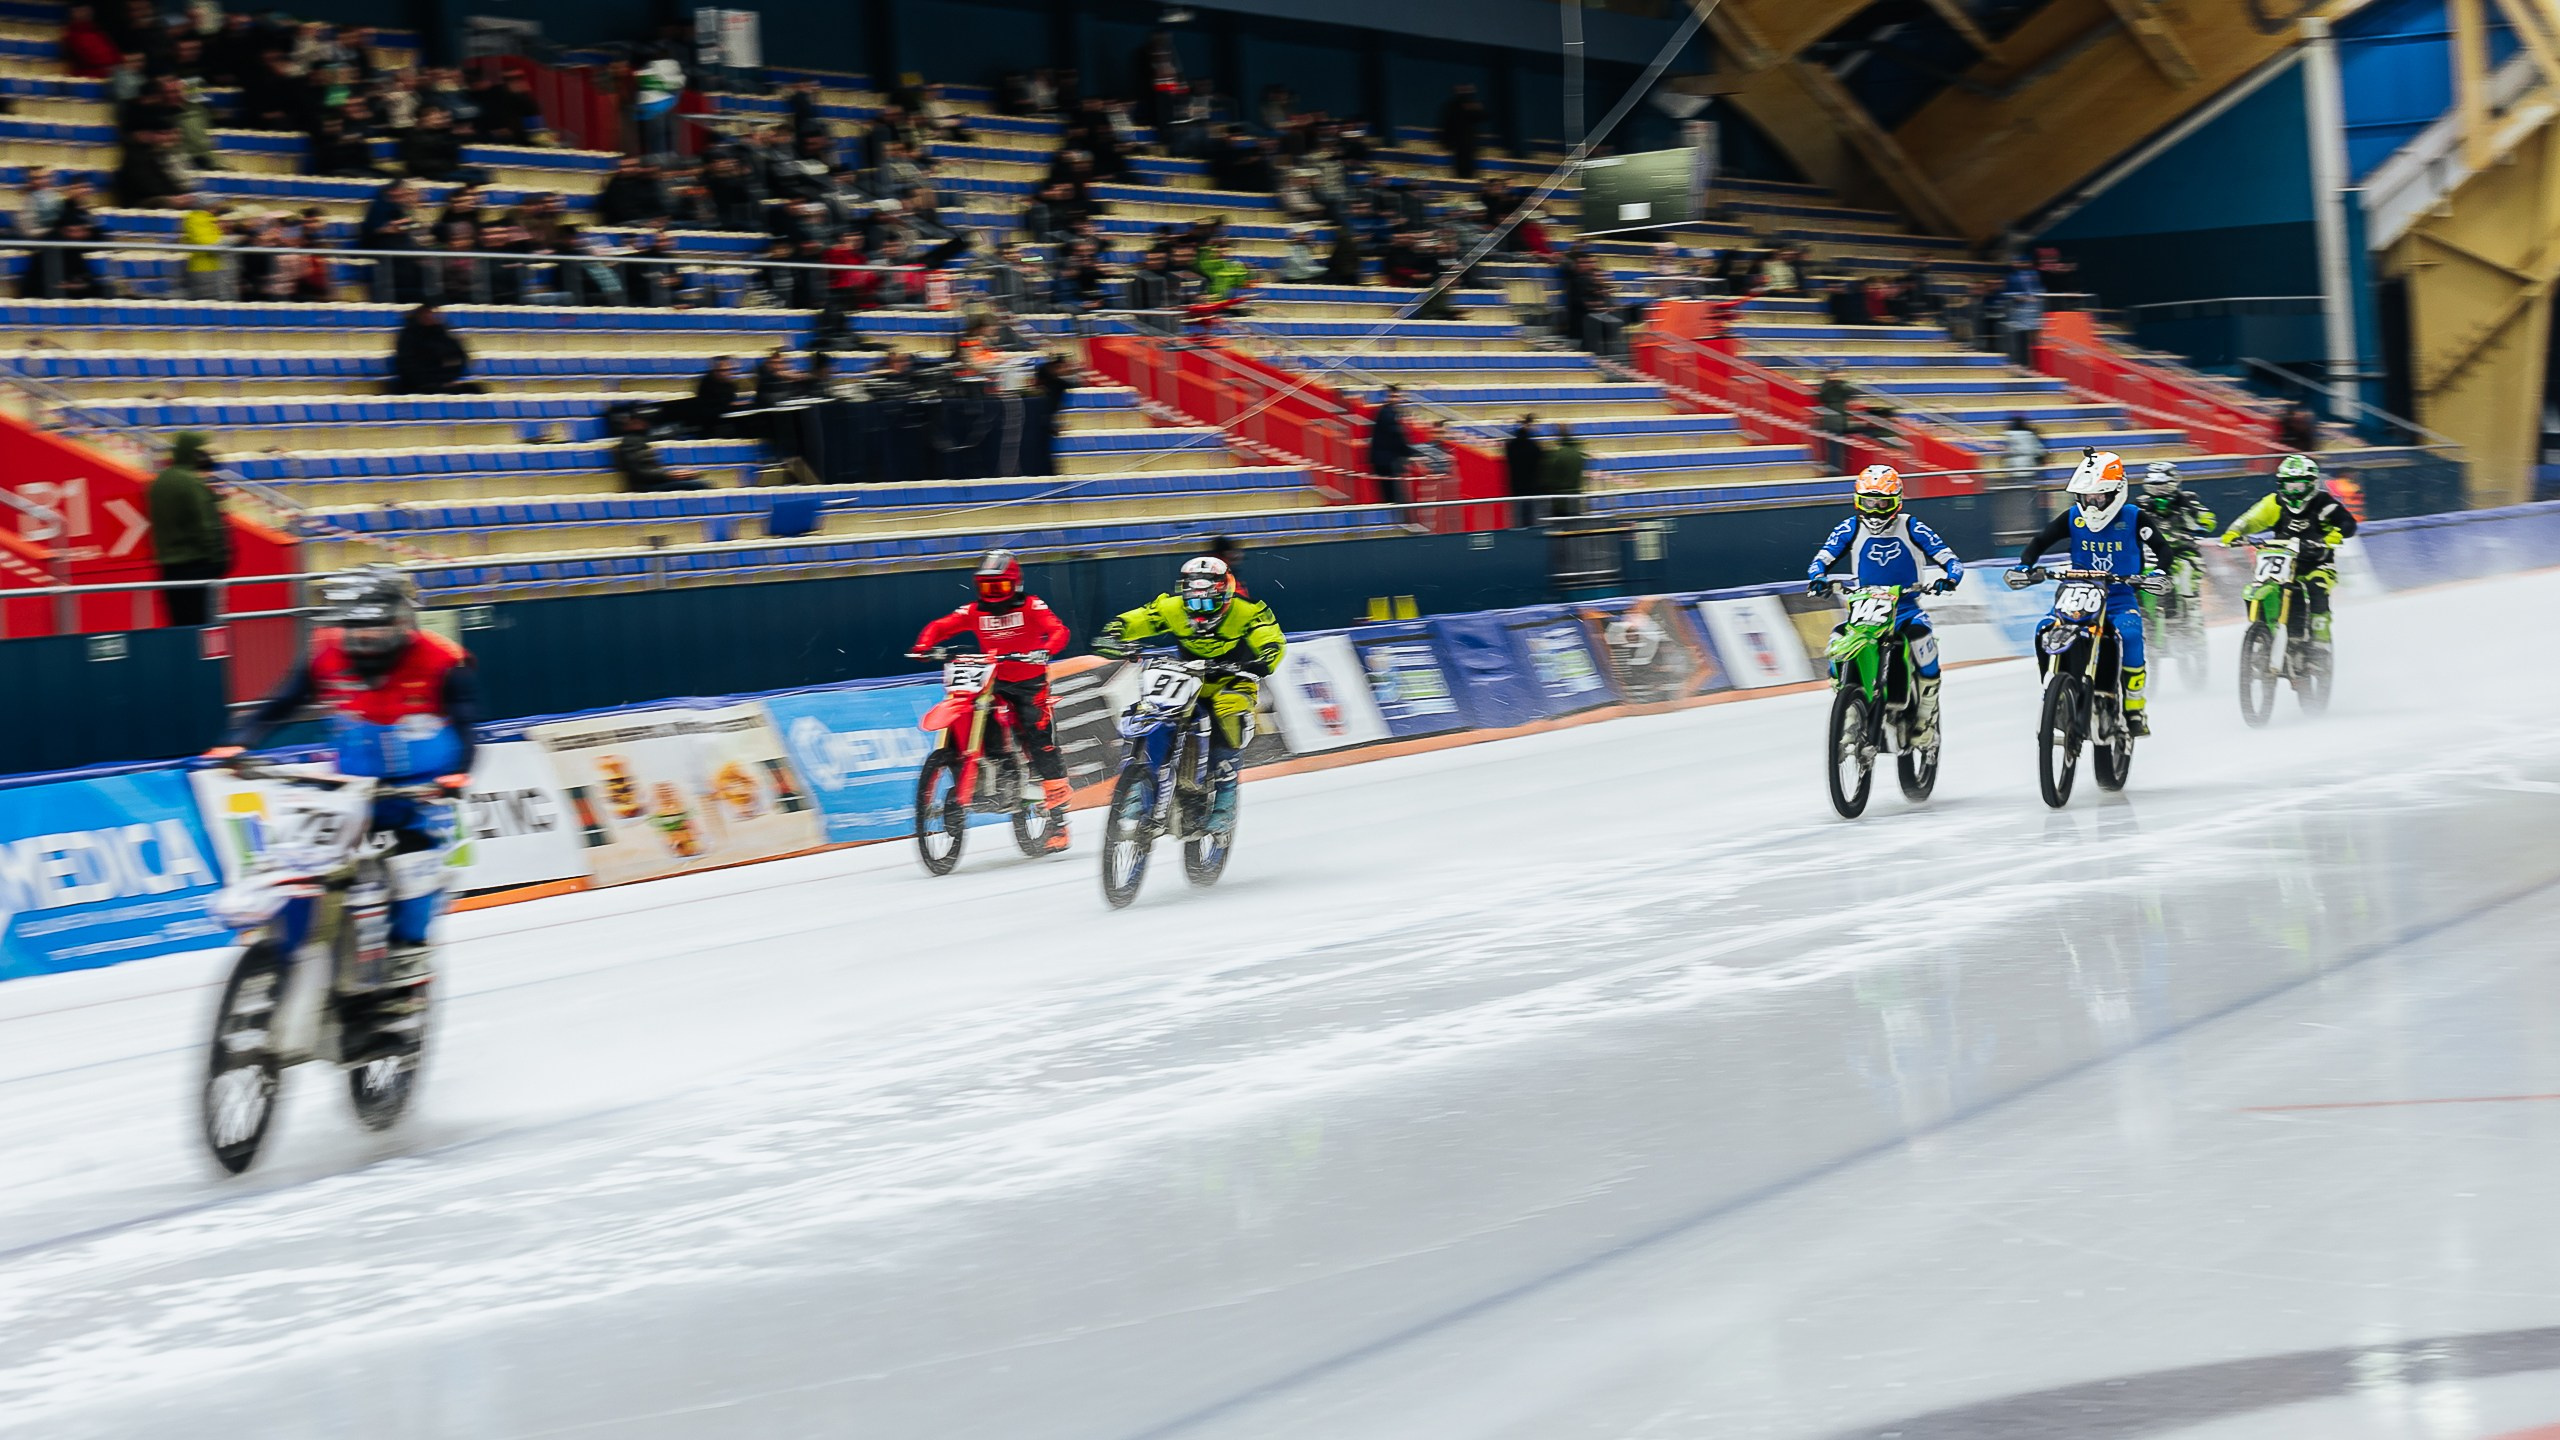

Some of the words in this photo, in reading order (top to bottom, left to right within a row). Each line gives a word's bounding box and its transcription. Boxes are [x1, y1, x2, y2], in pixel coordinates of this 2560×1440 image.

[2081, 540, 2122, 553] SEVEN
[1850, 598, 1893, 625] 142
[2055, 587, 2102, 613] 458
